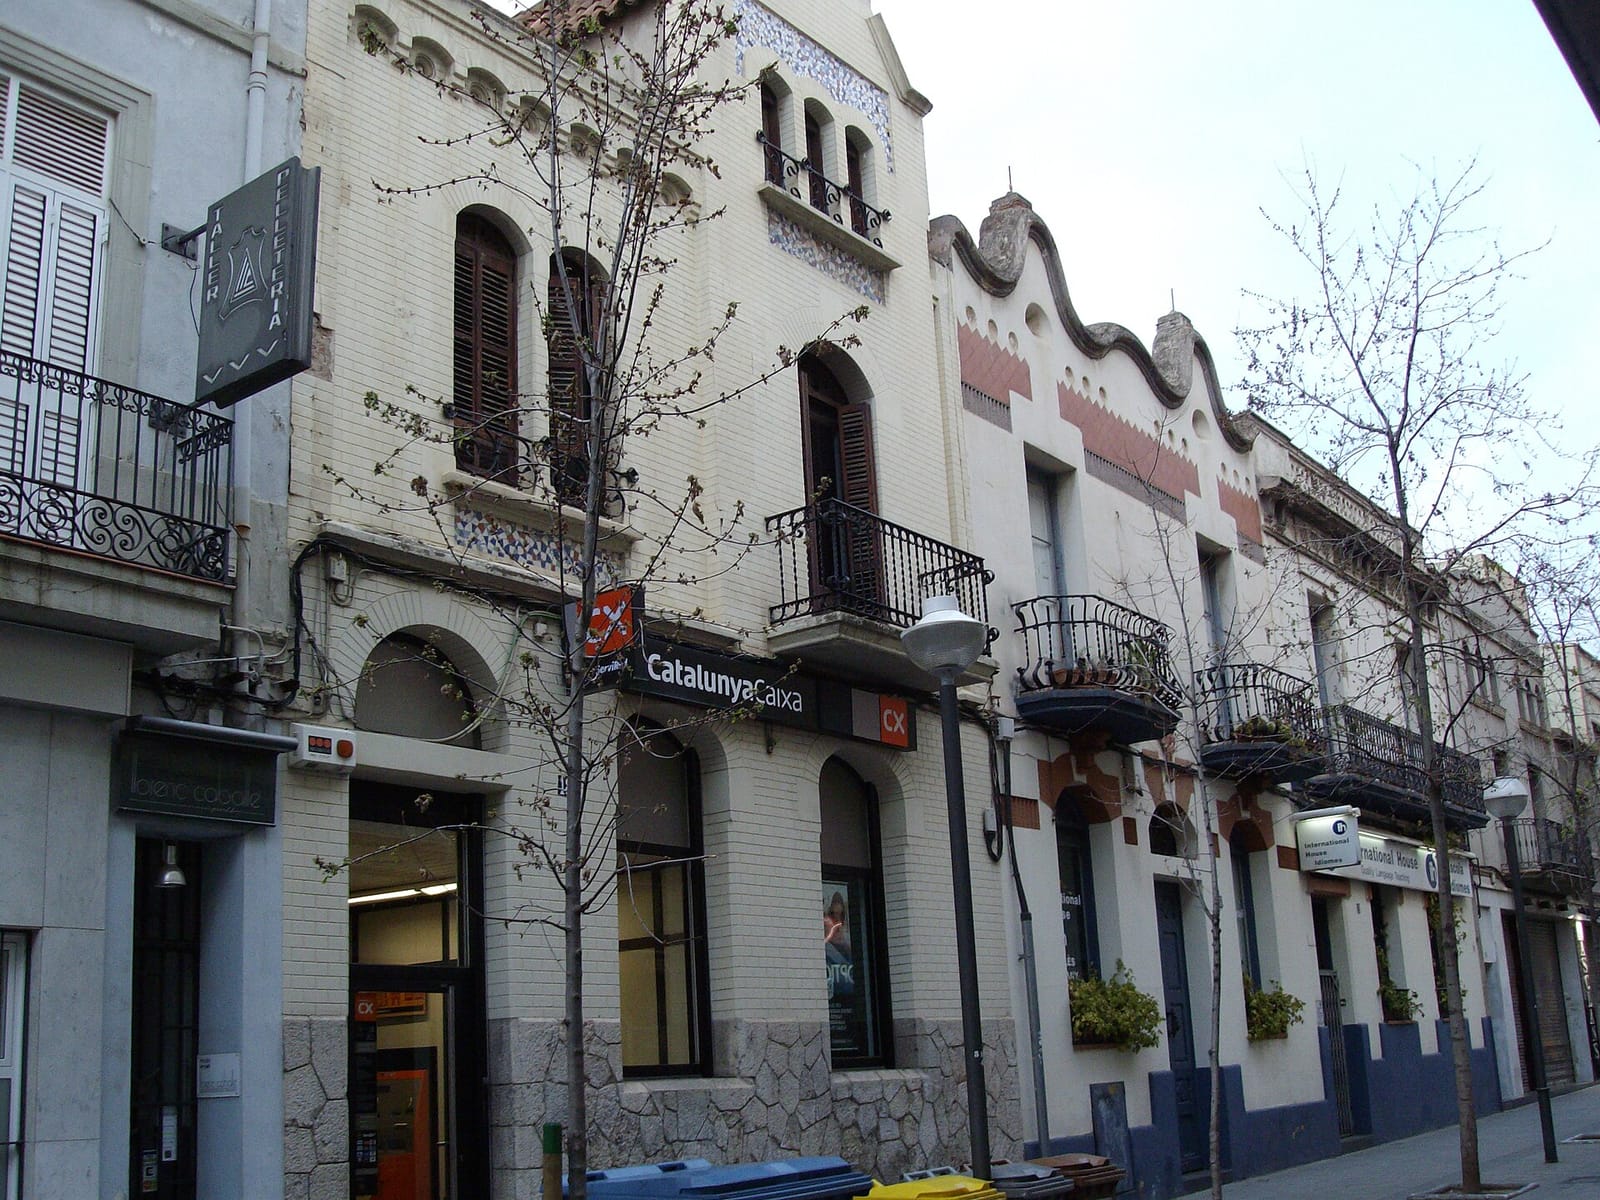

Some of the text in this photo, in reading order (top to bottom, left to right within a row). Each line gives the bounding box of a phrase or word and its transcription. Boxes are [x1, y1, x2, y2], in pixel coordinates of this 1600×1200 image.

[207, 206, 223, 303] TALLER
[269, 168, 290, 331] PELLETERIA
[647, 653, 803, 713] CatalunyaCaixa
[884, 709, 905, 735] CX
[1304, 838, 1350, 848] International
[1396, 851, 1419, 870] House
[357, 1002, 374, 1015] CX
